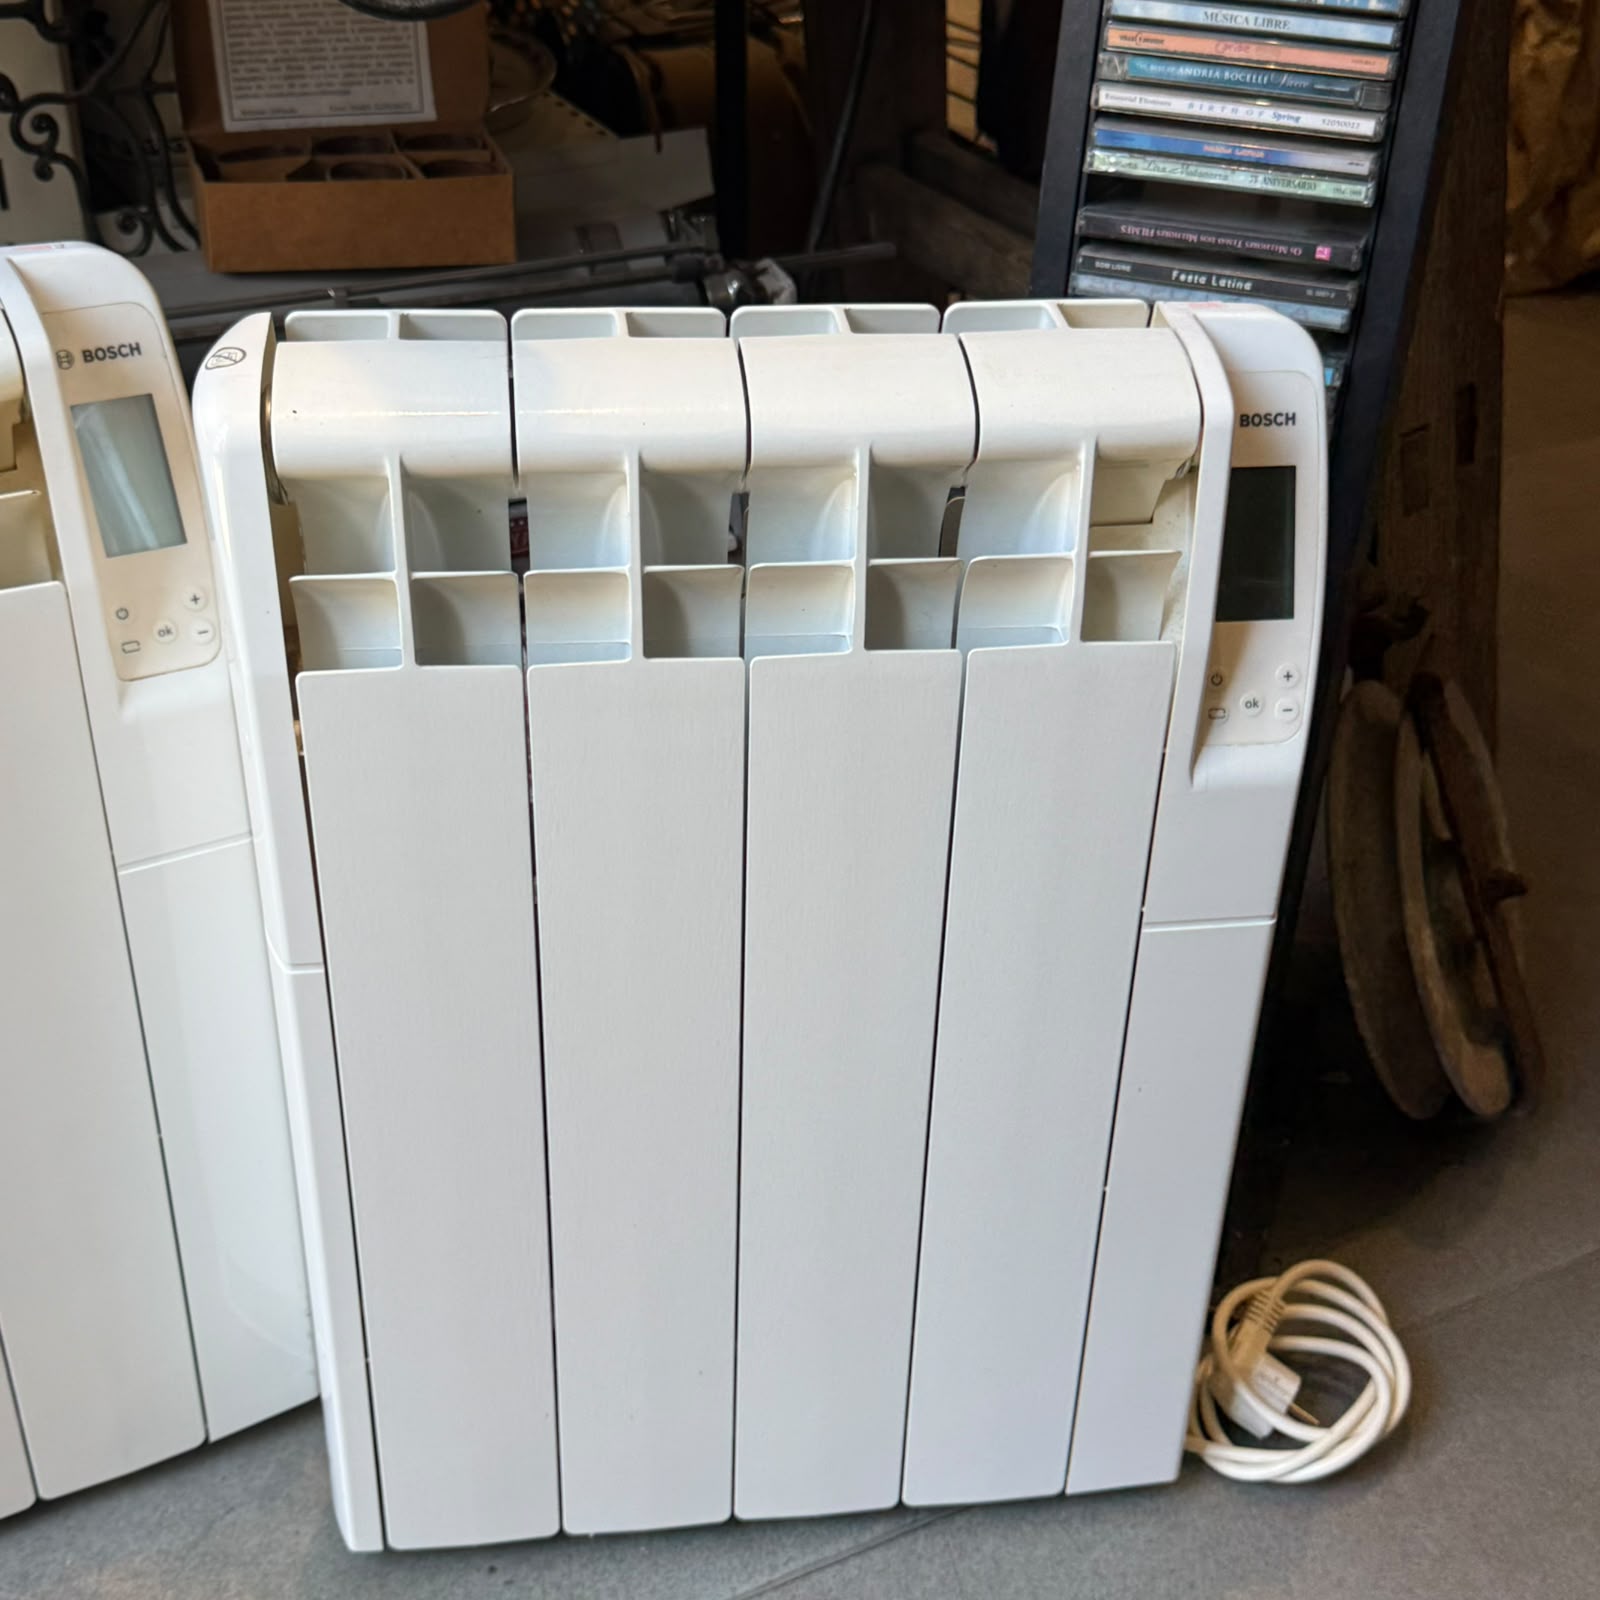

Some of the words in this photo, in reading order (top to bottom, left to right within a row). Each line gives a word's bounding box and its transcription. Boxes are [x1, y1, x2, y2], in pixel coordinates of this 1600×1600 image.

[1254, 15, 1290, 30] LIBRE
[1272, 111, 1302, 124] Spring
[1171, 269, 1207, 285] Festa
[1211, 274, 1253, 291] Latina
[82, 342, 142, 363] BOSCH
[1239, 411, 1297, 428] BOSCH
[157, 625, 174, 638] ok
[1244, 697, 1260, 710] ok
